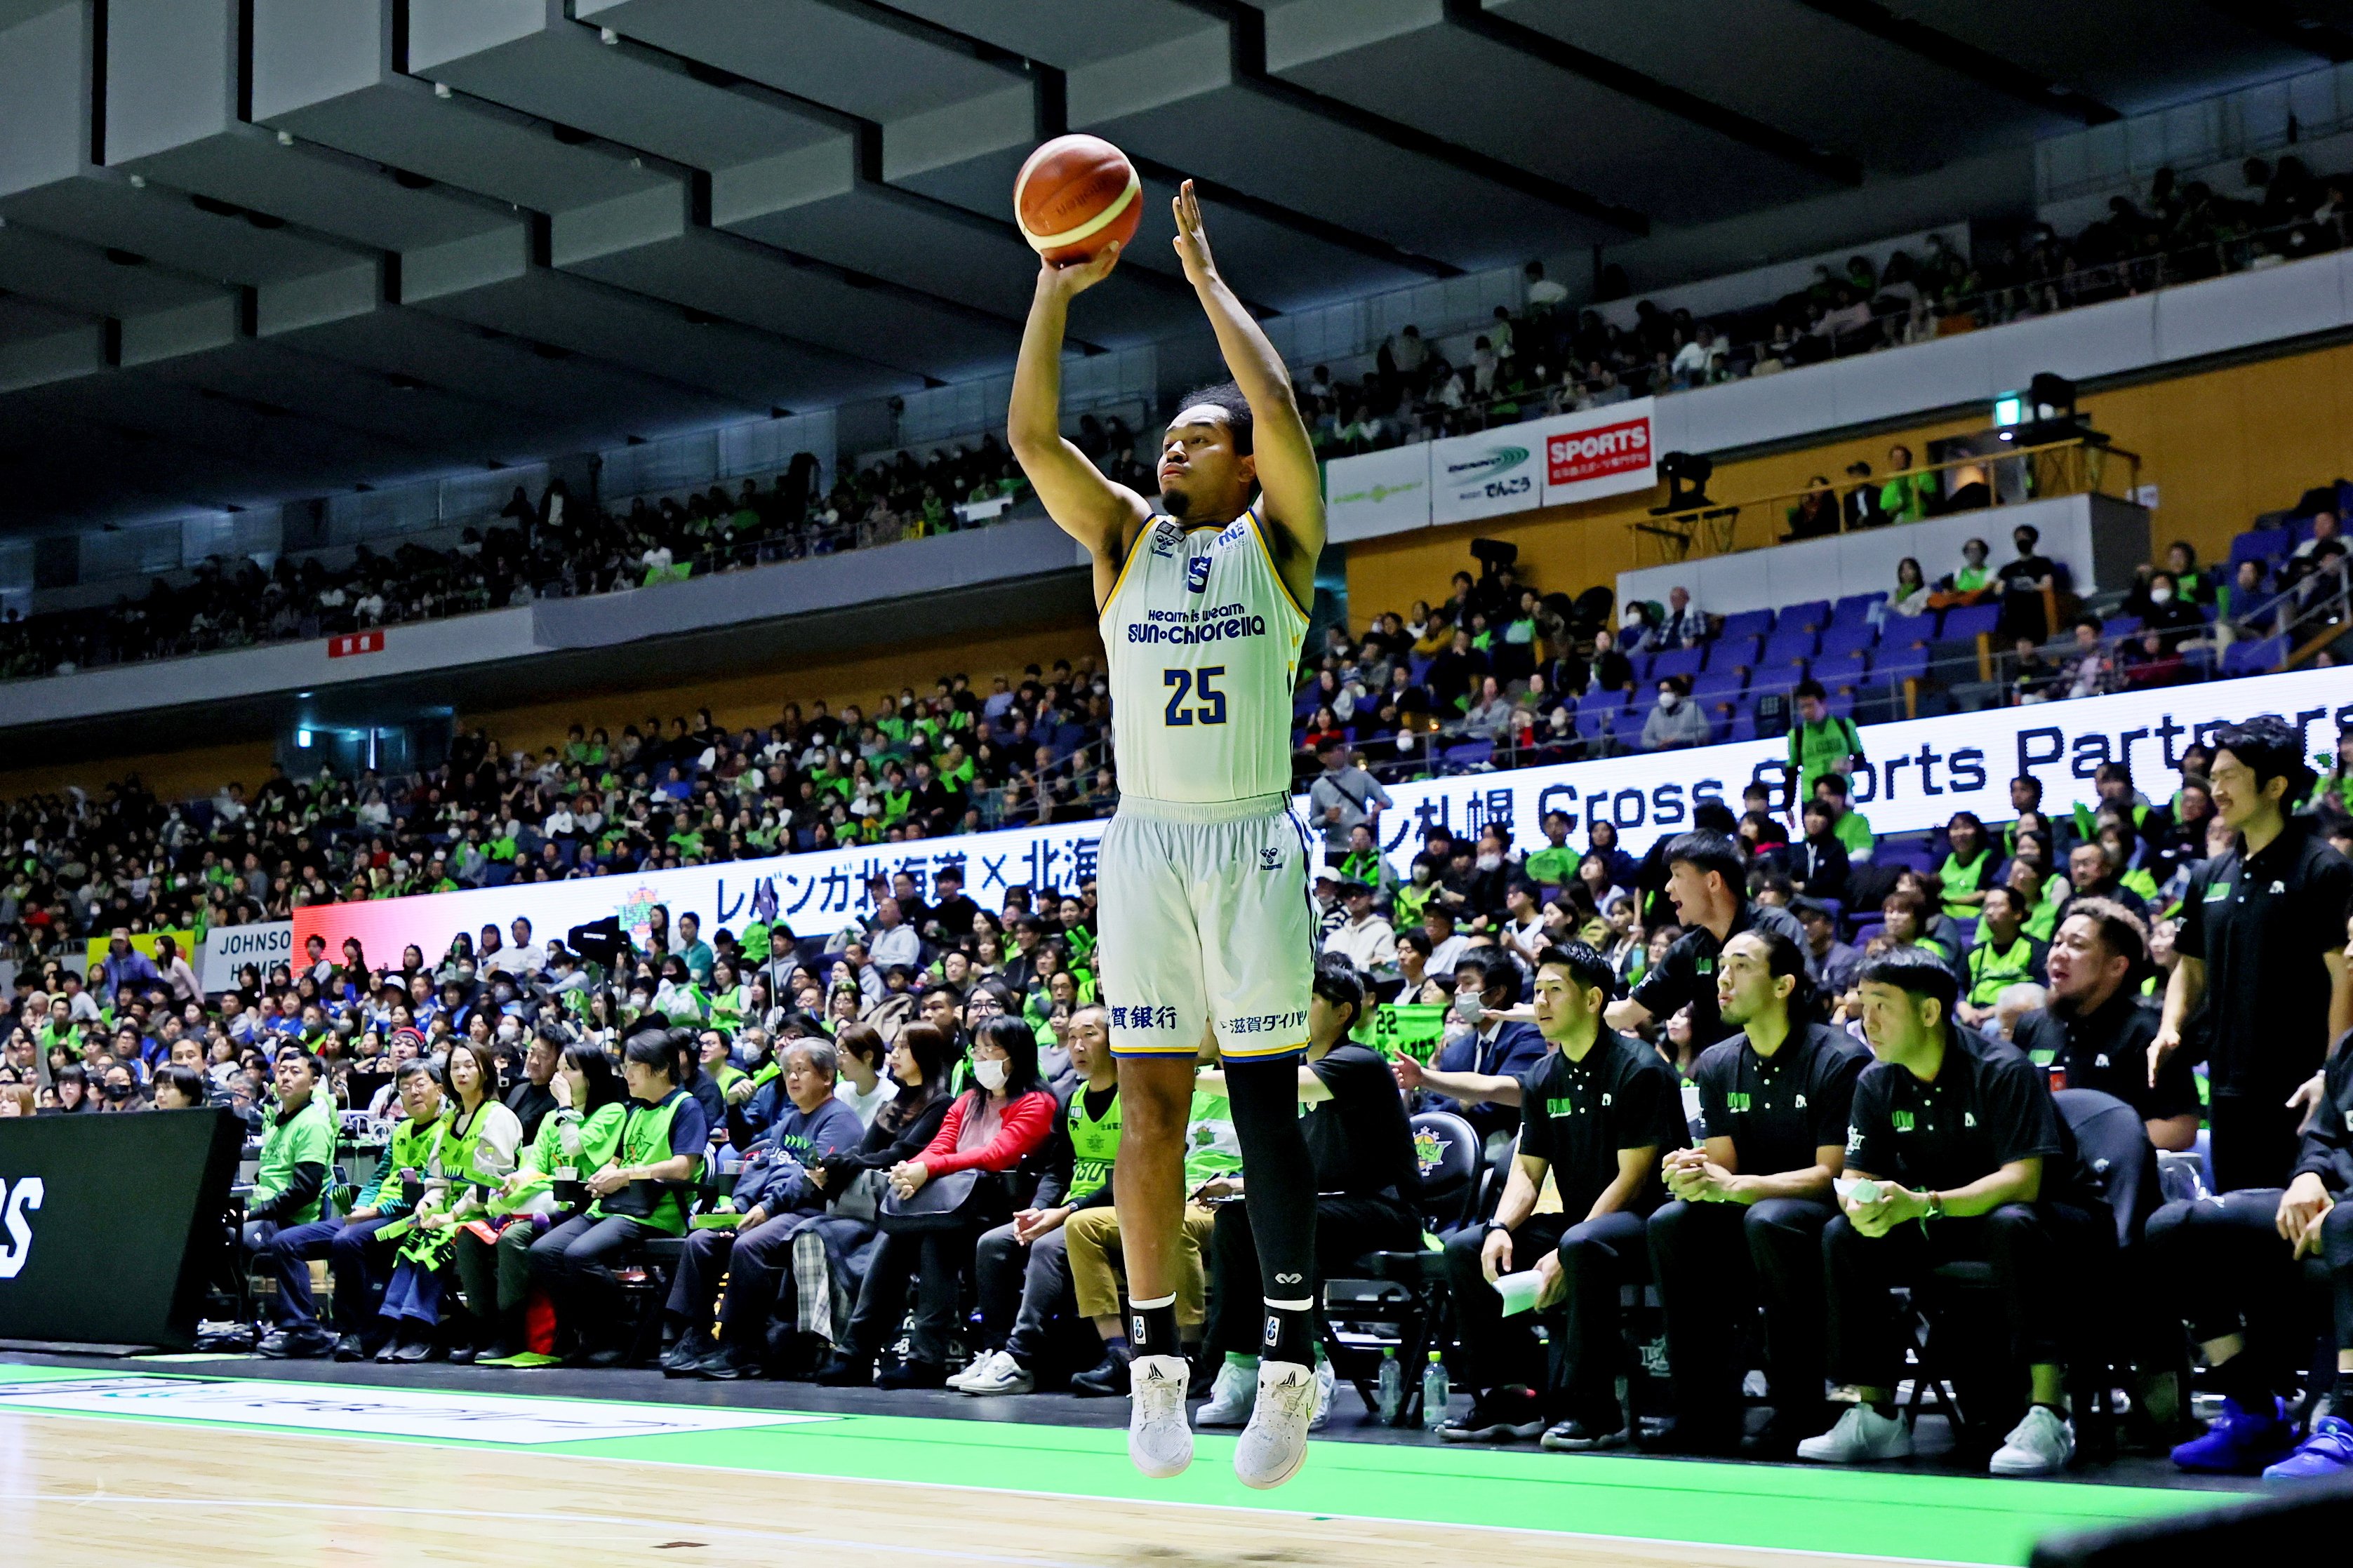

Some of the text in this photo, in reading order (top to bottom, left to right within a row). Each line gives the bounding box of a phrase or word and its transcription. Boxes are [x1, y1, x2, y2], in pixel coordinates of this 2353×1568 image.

[1551, 426, 1648, 464] SPORTS
[1191, 609, 1200, 622] is
[1164, 664, 1227, 728] 25
[1752, 742, 1987, 812] Sorts
[2018, 703, 2353, 777] Partr
[1107, 1005, 1178, 1030] 賀銀行
[1376, 1010, 1399, 1035] 22
